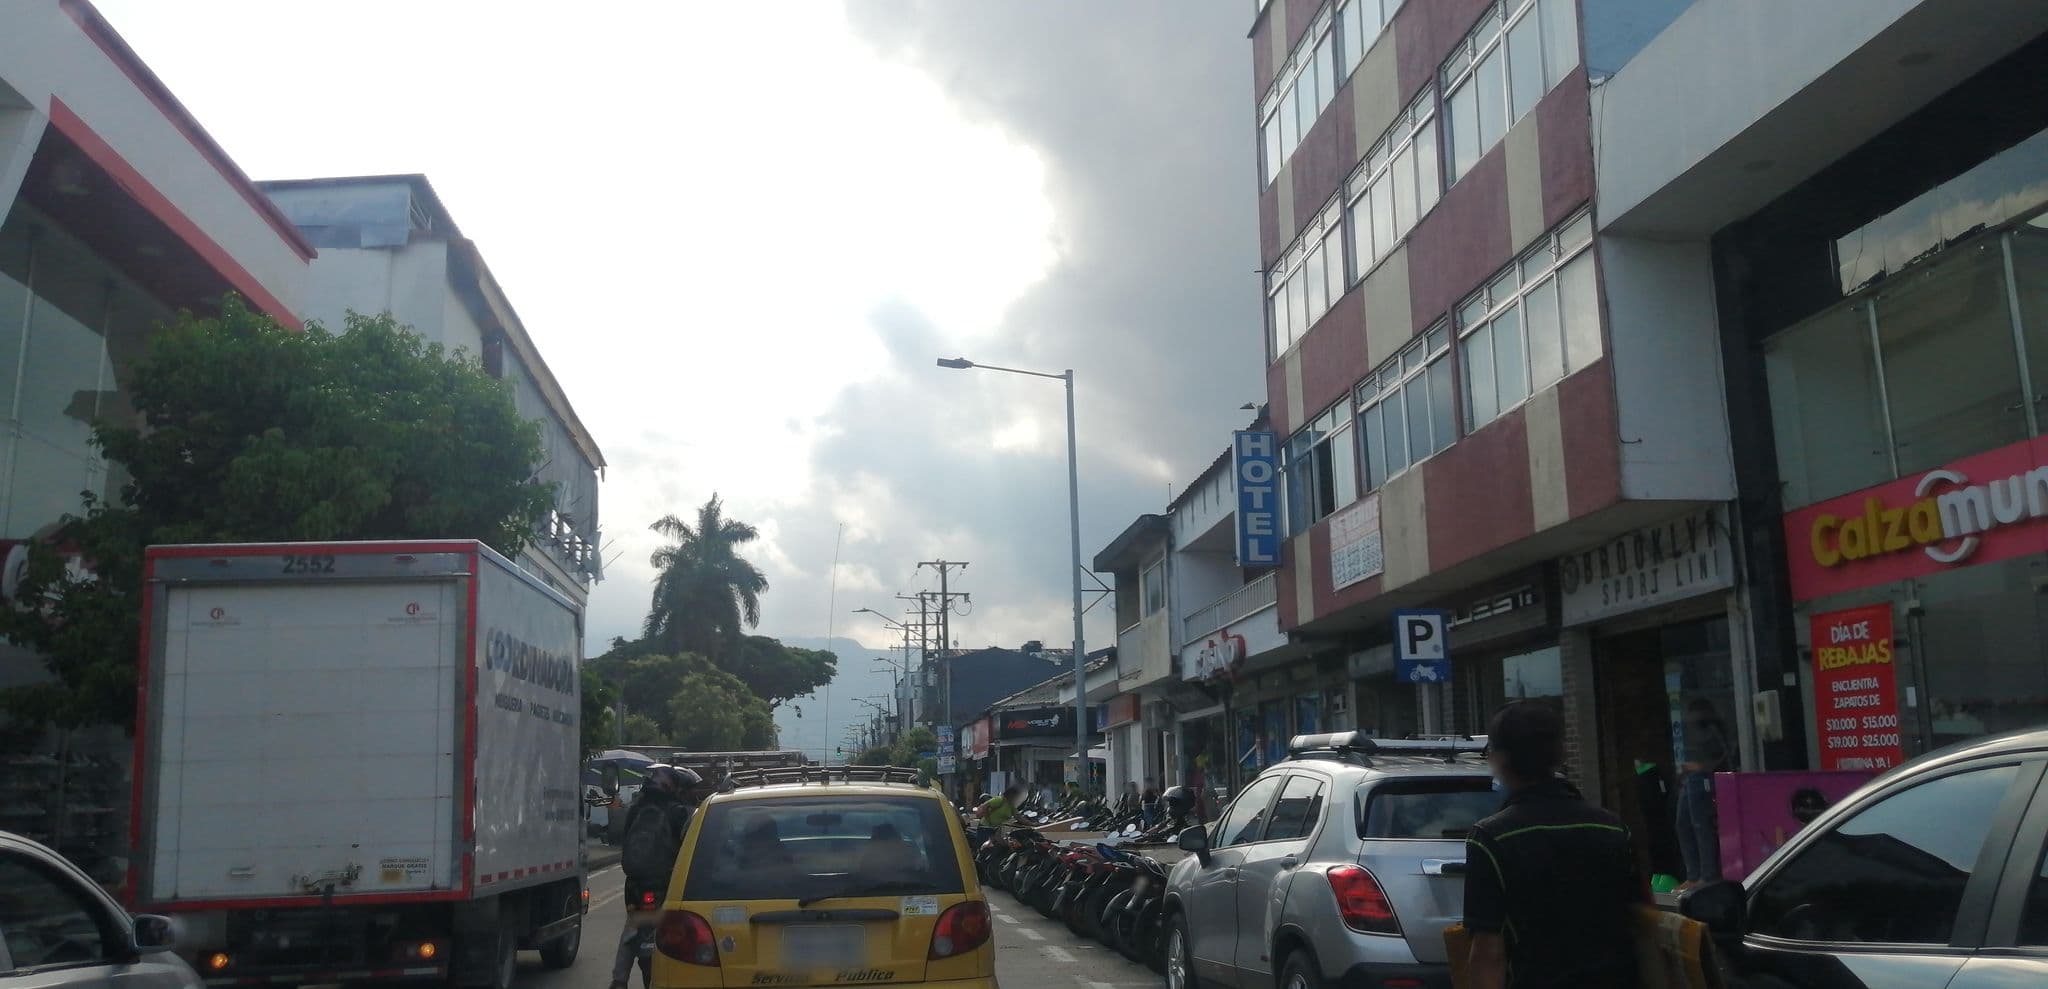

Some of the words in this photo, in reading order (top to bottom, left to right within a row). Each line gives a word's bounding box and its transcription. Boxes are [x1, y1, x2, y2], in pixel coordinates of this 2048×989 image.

[1241, 434, 1273, 562] HOTEL
[282, 555, 335, 574] 2552
[1407, 619, 1434, 655] P
[1831, 622, 1852, 643] DÍA
[1853, 621, 1870, 640] DE
[1818, 638, 1891, 671] REBAJAS
[1832, 677, 1879, 693] ENCUENTRA
[1833, 695, 1868, 709] ZAPATOS
[1869, 694, 1881, 706] DE
[1826, 717, 1857, 731] $10.000
[1862, 714, 1897, 729] $15.000
[1828, 735, 1858, 749] $19.000
[1862, 733, 1899, 747] $25.000
